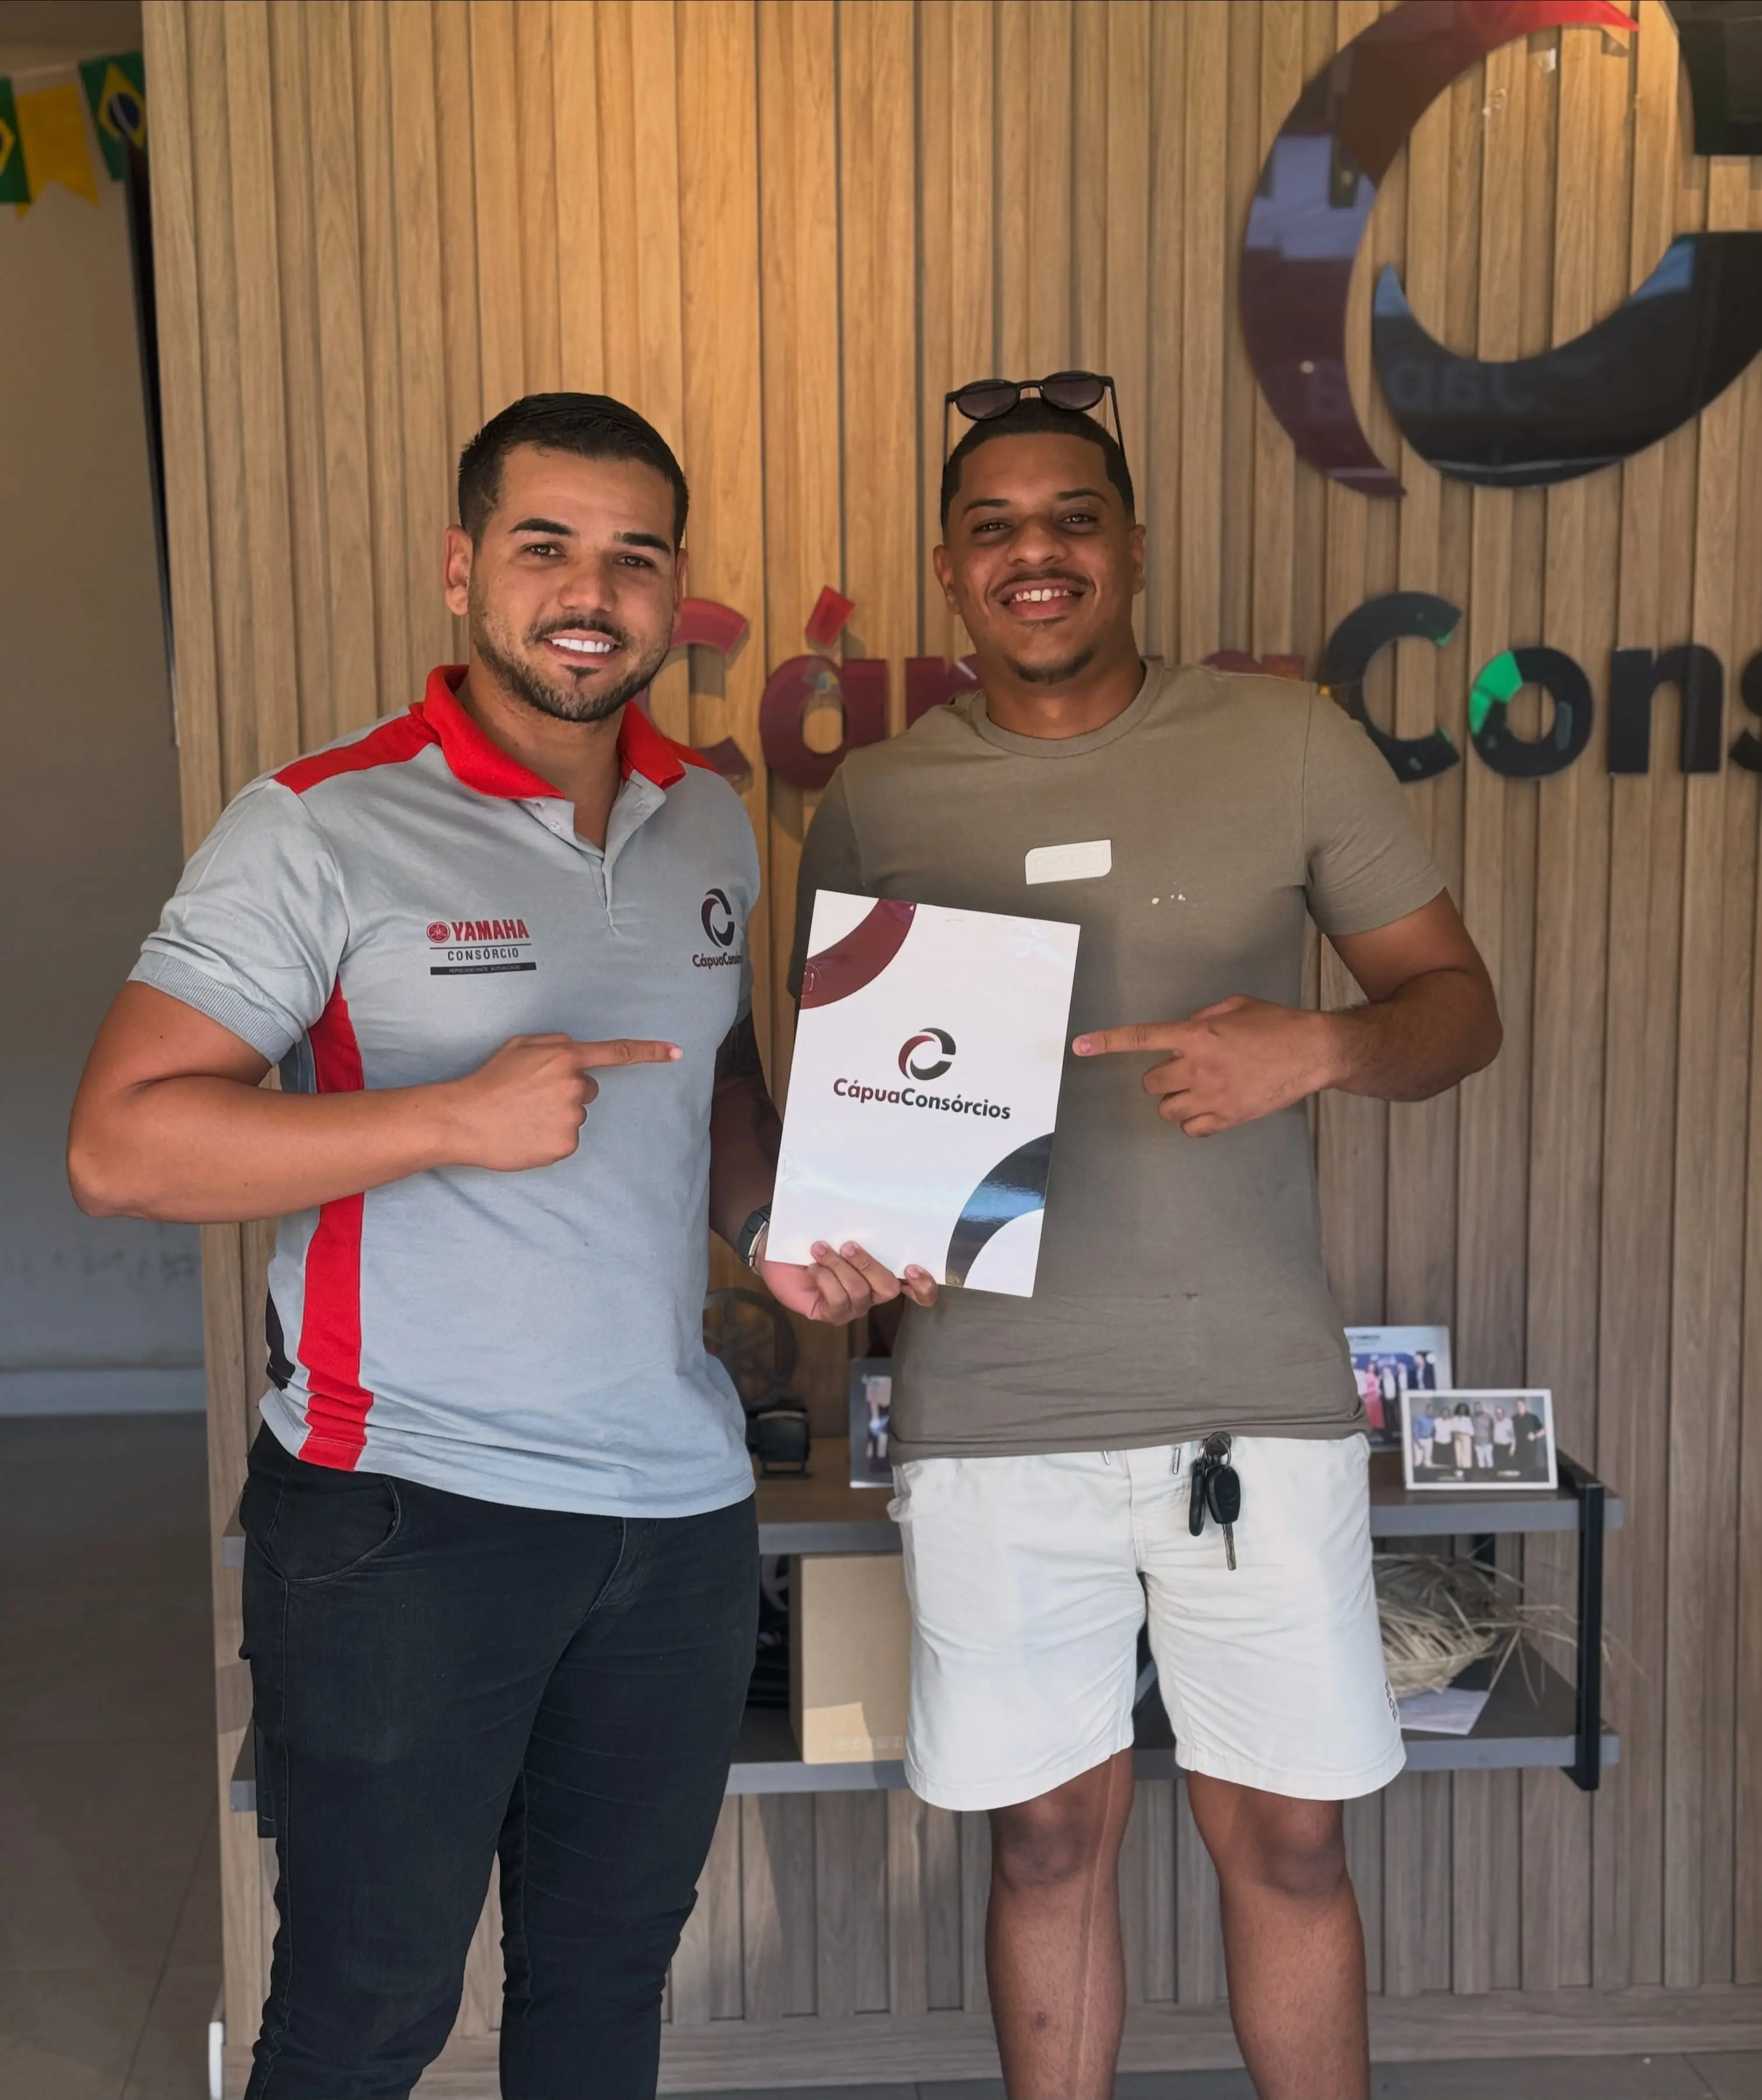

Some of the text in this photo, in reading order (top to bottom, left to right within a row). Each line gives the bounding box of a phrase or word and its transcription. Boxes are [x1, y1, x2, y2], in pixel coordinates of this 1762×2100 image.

[451, 919, 530, 941] YAMAHA
[447, 947, 519, 961] CONSÓRCIO
[833, 1078, 1011, 1119] CápuaConsórcios
